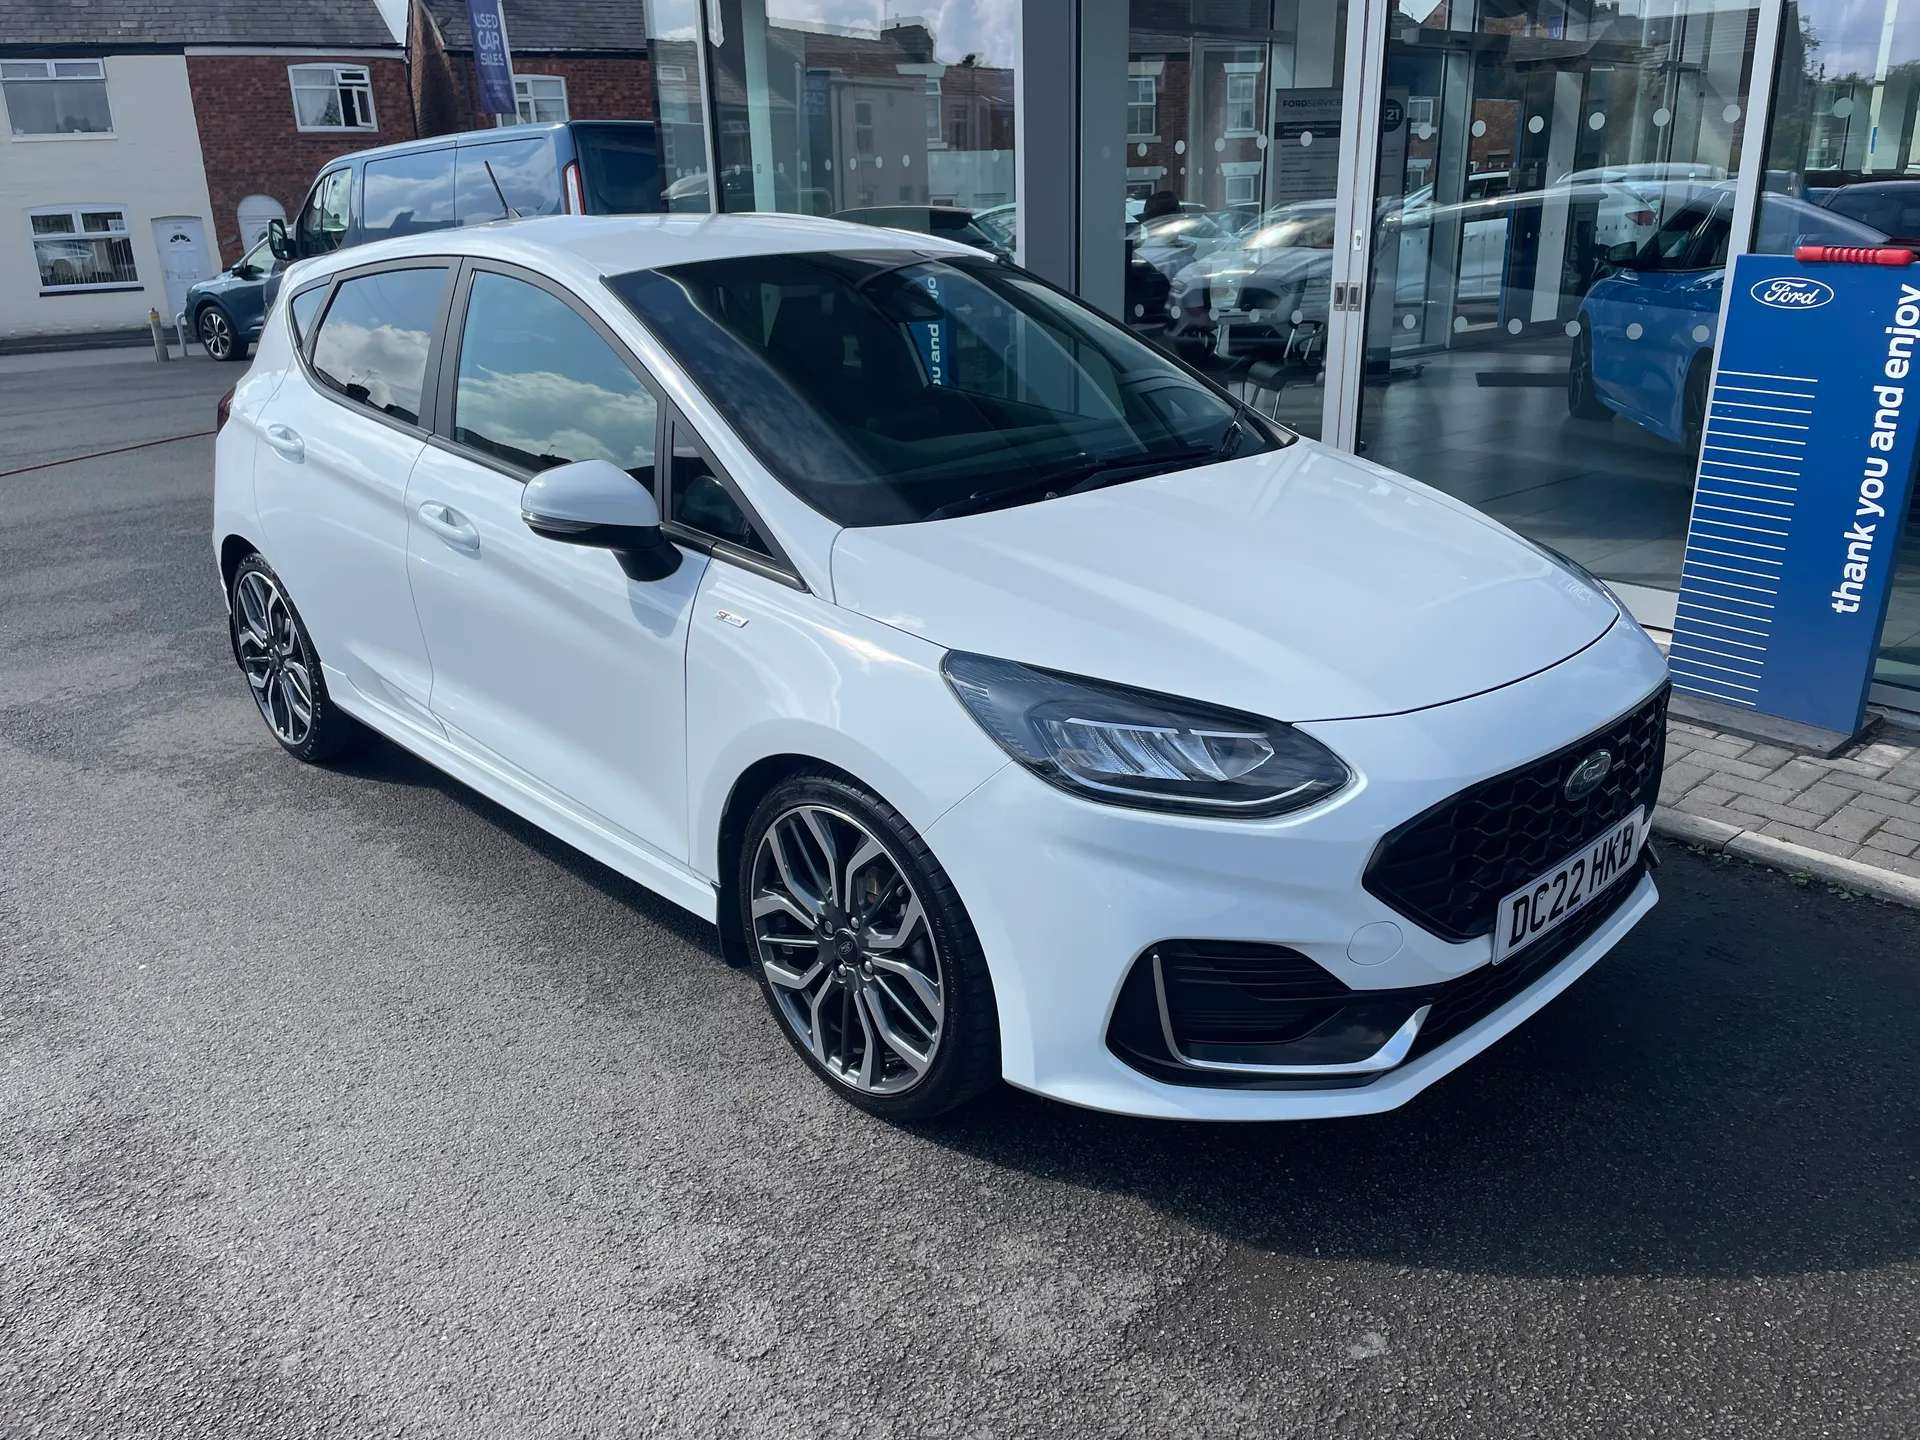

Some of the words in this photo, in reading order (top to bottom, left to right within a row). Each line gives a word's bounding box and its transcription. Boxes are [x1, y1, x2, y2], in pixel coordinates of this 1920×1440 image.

[473, 13, 498, 29] USED
[478, 31, 500, 50] CAR
[1763, 280, 1821, 305] Ford
[927, 323, 941, 363] and
[1884, 283, 1920, 379] enjoy
[1870, 385, 1905, 451] and
[1855, 456, 1889, 518] you
[1831, 521, 1877, 614] thank
[1508, 858, 1586, 949] DC22
[1588, 821, 1635, 894] HKB
